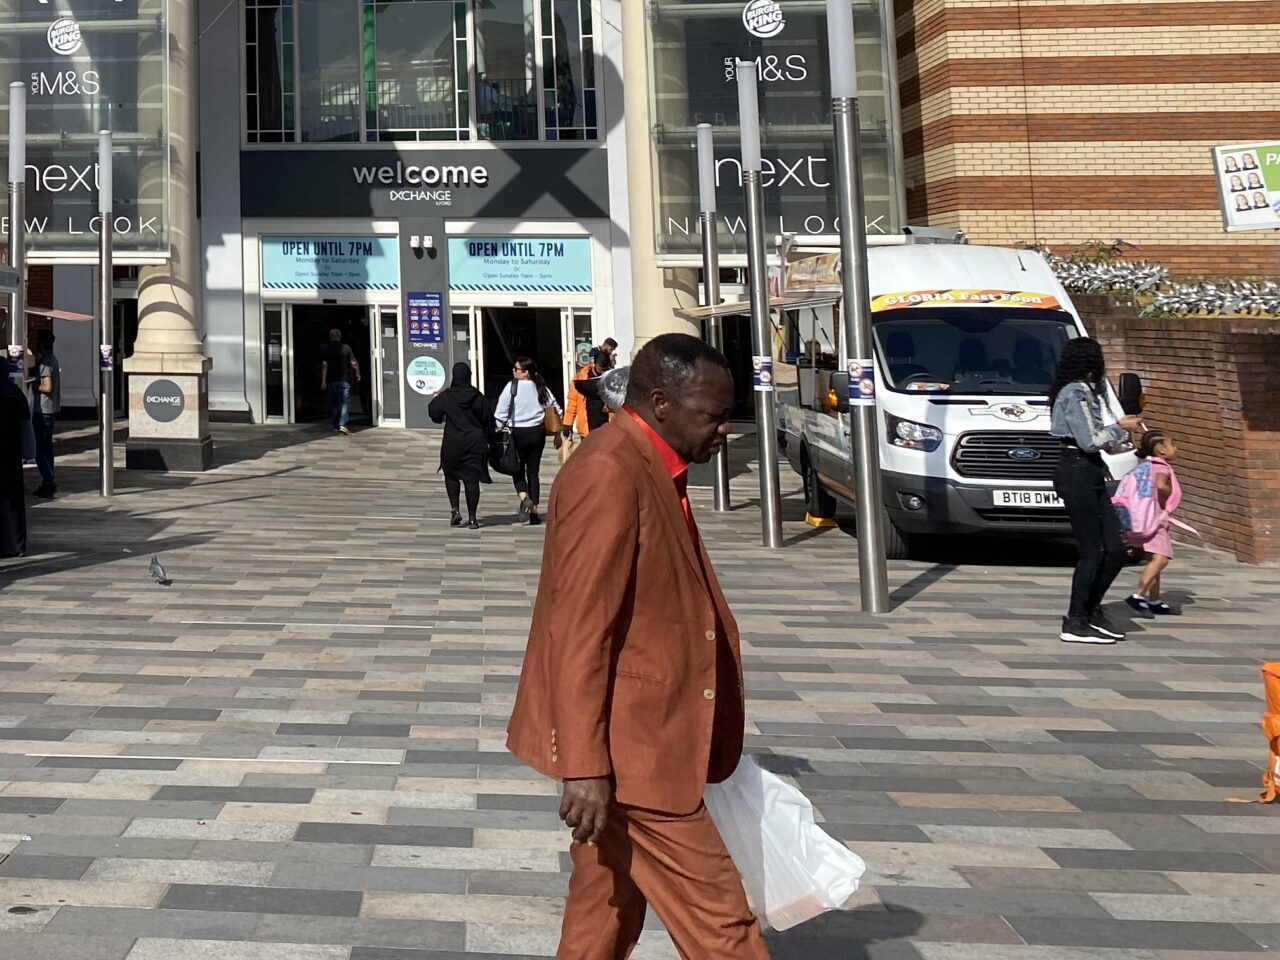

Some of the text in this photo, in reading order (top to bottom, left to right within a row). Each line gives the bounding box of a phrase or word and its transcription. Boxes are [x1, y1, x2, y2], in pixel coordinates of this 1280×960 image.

[747, 3, 780, 20] BURGER
[748, 10, 783, 31] KING
[50, 24, 80, 38] BURGER
[51, 31, 81, 48] KING
[724, 56, 733, 82] YOUR
[31, 71, 100, 95] YOUR M&S
[352, 161, 488, 184] welcome
[715, 156, 830, 188] next
[389, 190, 451, 201] EXCHANGE
[69, 216, 157, 234] LOOK
[668, 215, 747, 235] NW
[282, 241, 373, 256] OPEN UNTIL 7PM
[469, 242, 564, 257] OPEN UNTIL 7PM
[521, 258, 551, 266] Saturday
[884, 292, 1043, 305] GLORIA Fast Food
[1003, 492, 1060, 504] BT18 DWM
